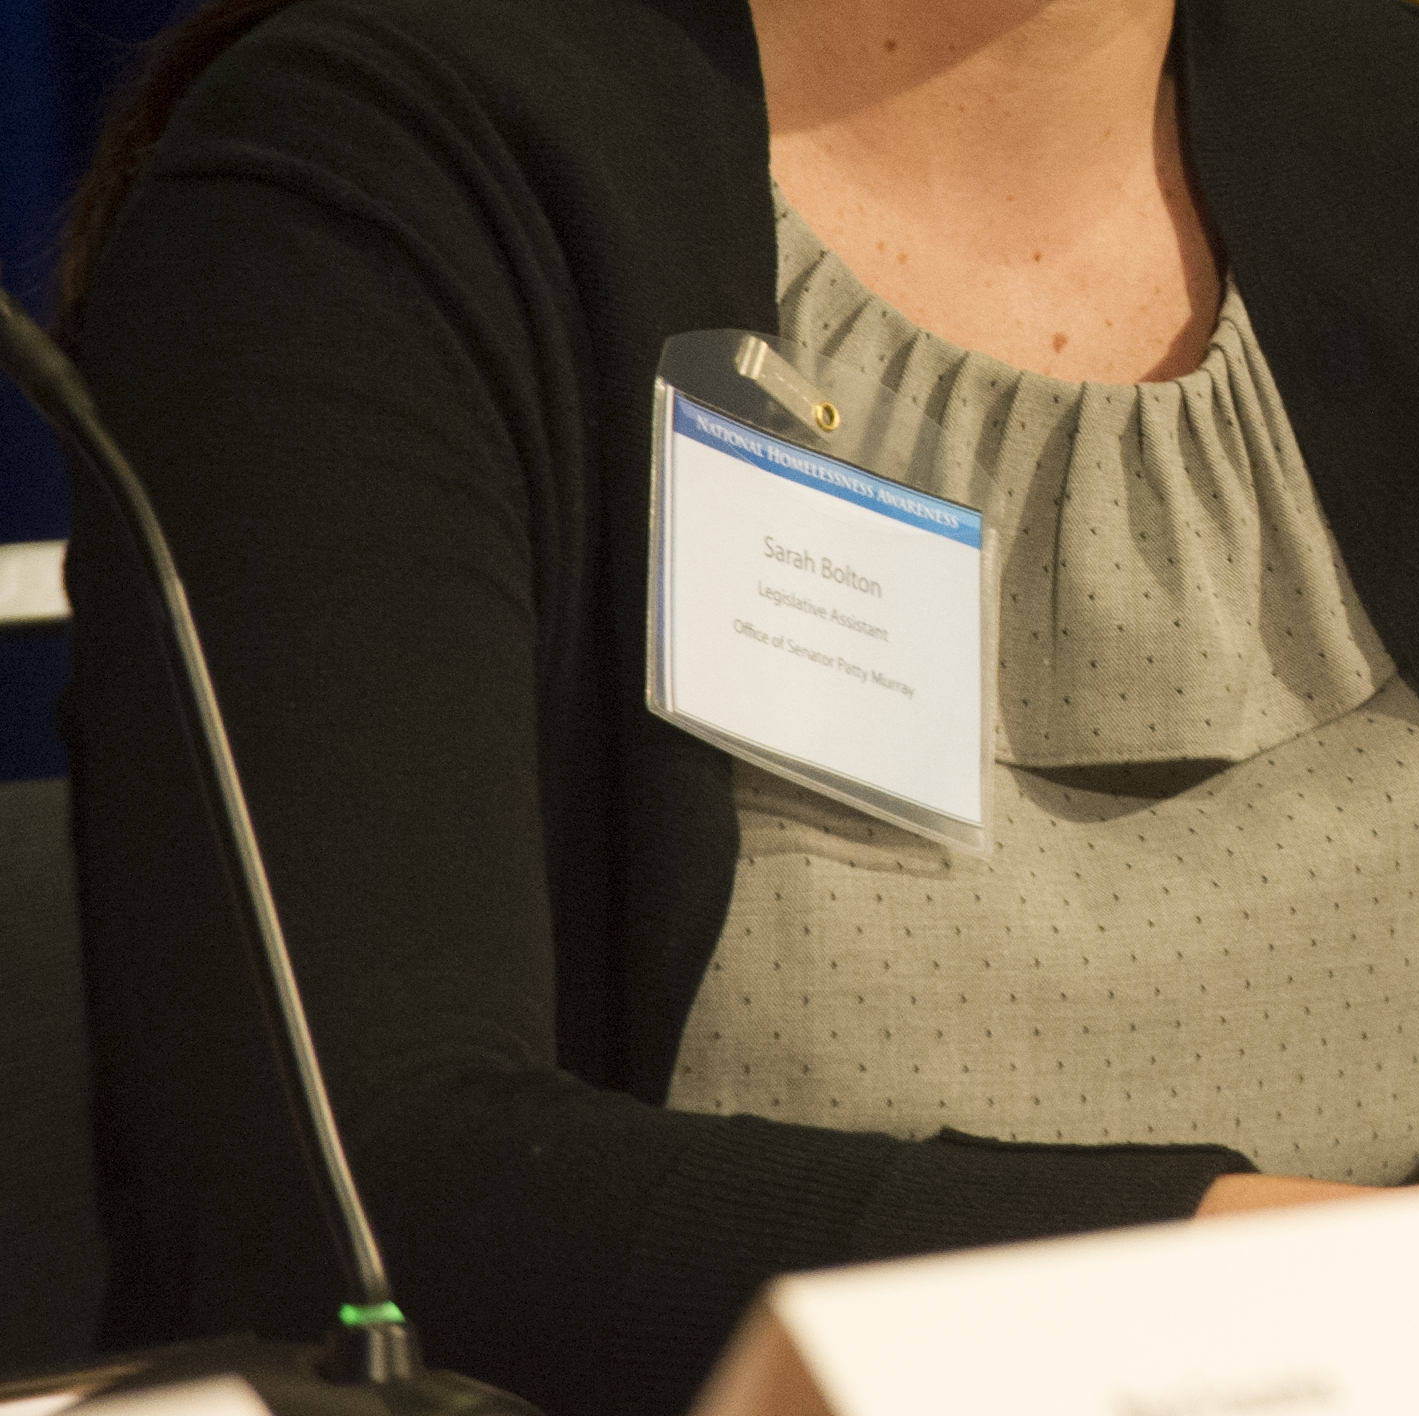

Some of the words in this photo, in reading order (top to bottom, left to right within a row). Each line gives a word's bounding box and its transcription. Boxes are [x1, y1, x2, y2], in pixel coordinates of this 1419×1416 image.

[696, 414, 765, 458] NATIONAL
[767, 445, 875, 499] HOMELESSNESS
[876, 488, 959, 529] AWARENESS
[763, 535, 816, 573] Sarah
[820, 556, 883, 599] Bolton
[757, 581, 828, 620] Legislative
[830, 608, 889, 643] Assistant
[733, 618, 770, 645] Office
[771, 635, 785, 650] of
[787, 638, 834, 666] Senator
[837, 656, 868, 684] Patty
[871, 669, 916, 701] Murray
